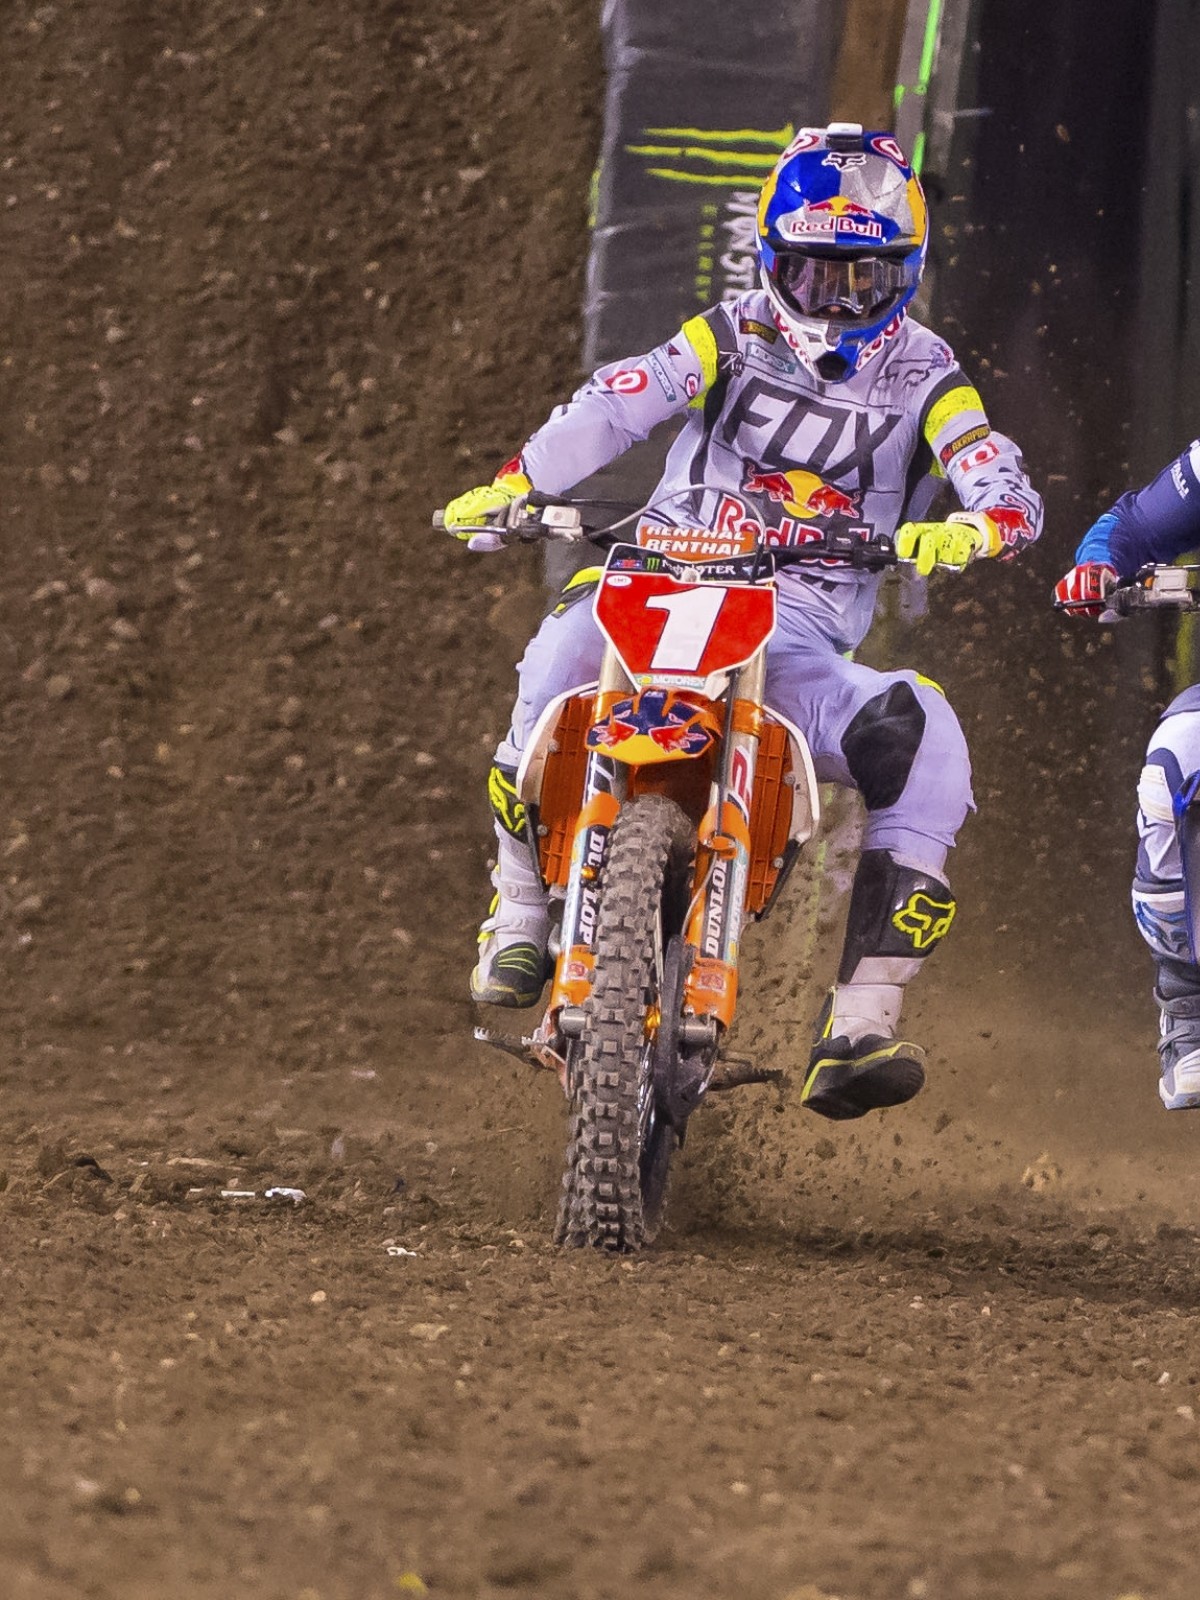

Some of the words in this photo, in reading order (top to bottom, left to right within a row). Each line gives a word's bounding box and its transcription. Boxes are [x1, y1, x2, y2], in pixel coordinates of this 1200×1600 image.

[790, 215, 835, 235] Red
[838, 217, 882, 238] Bull
[723, 377, 901, 487] FOX
[645, 587, 729, 672] 1
[579, 830, 605, 945] DULOP
